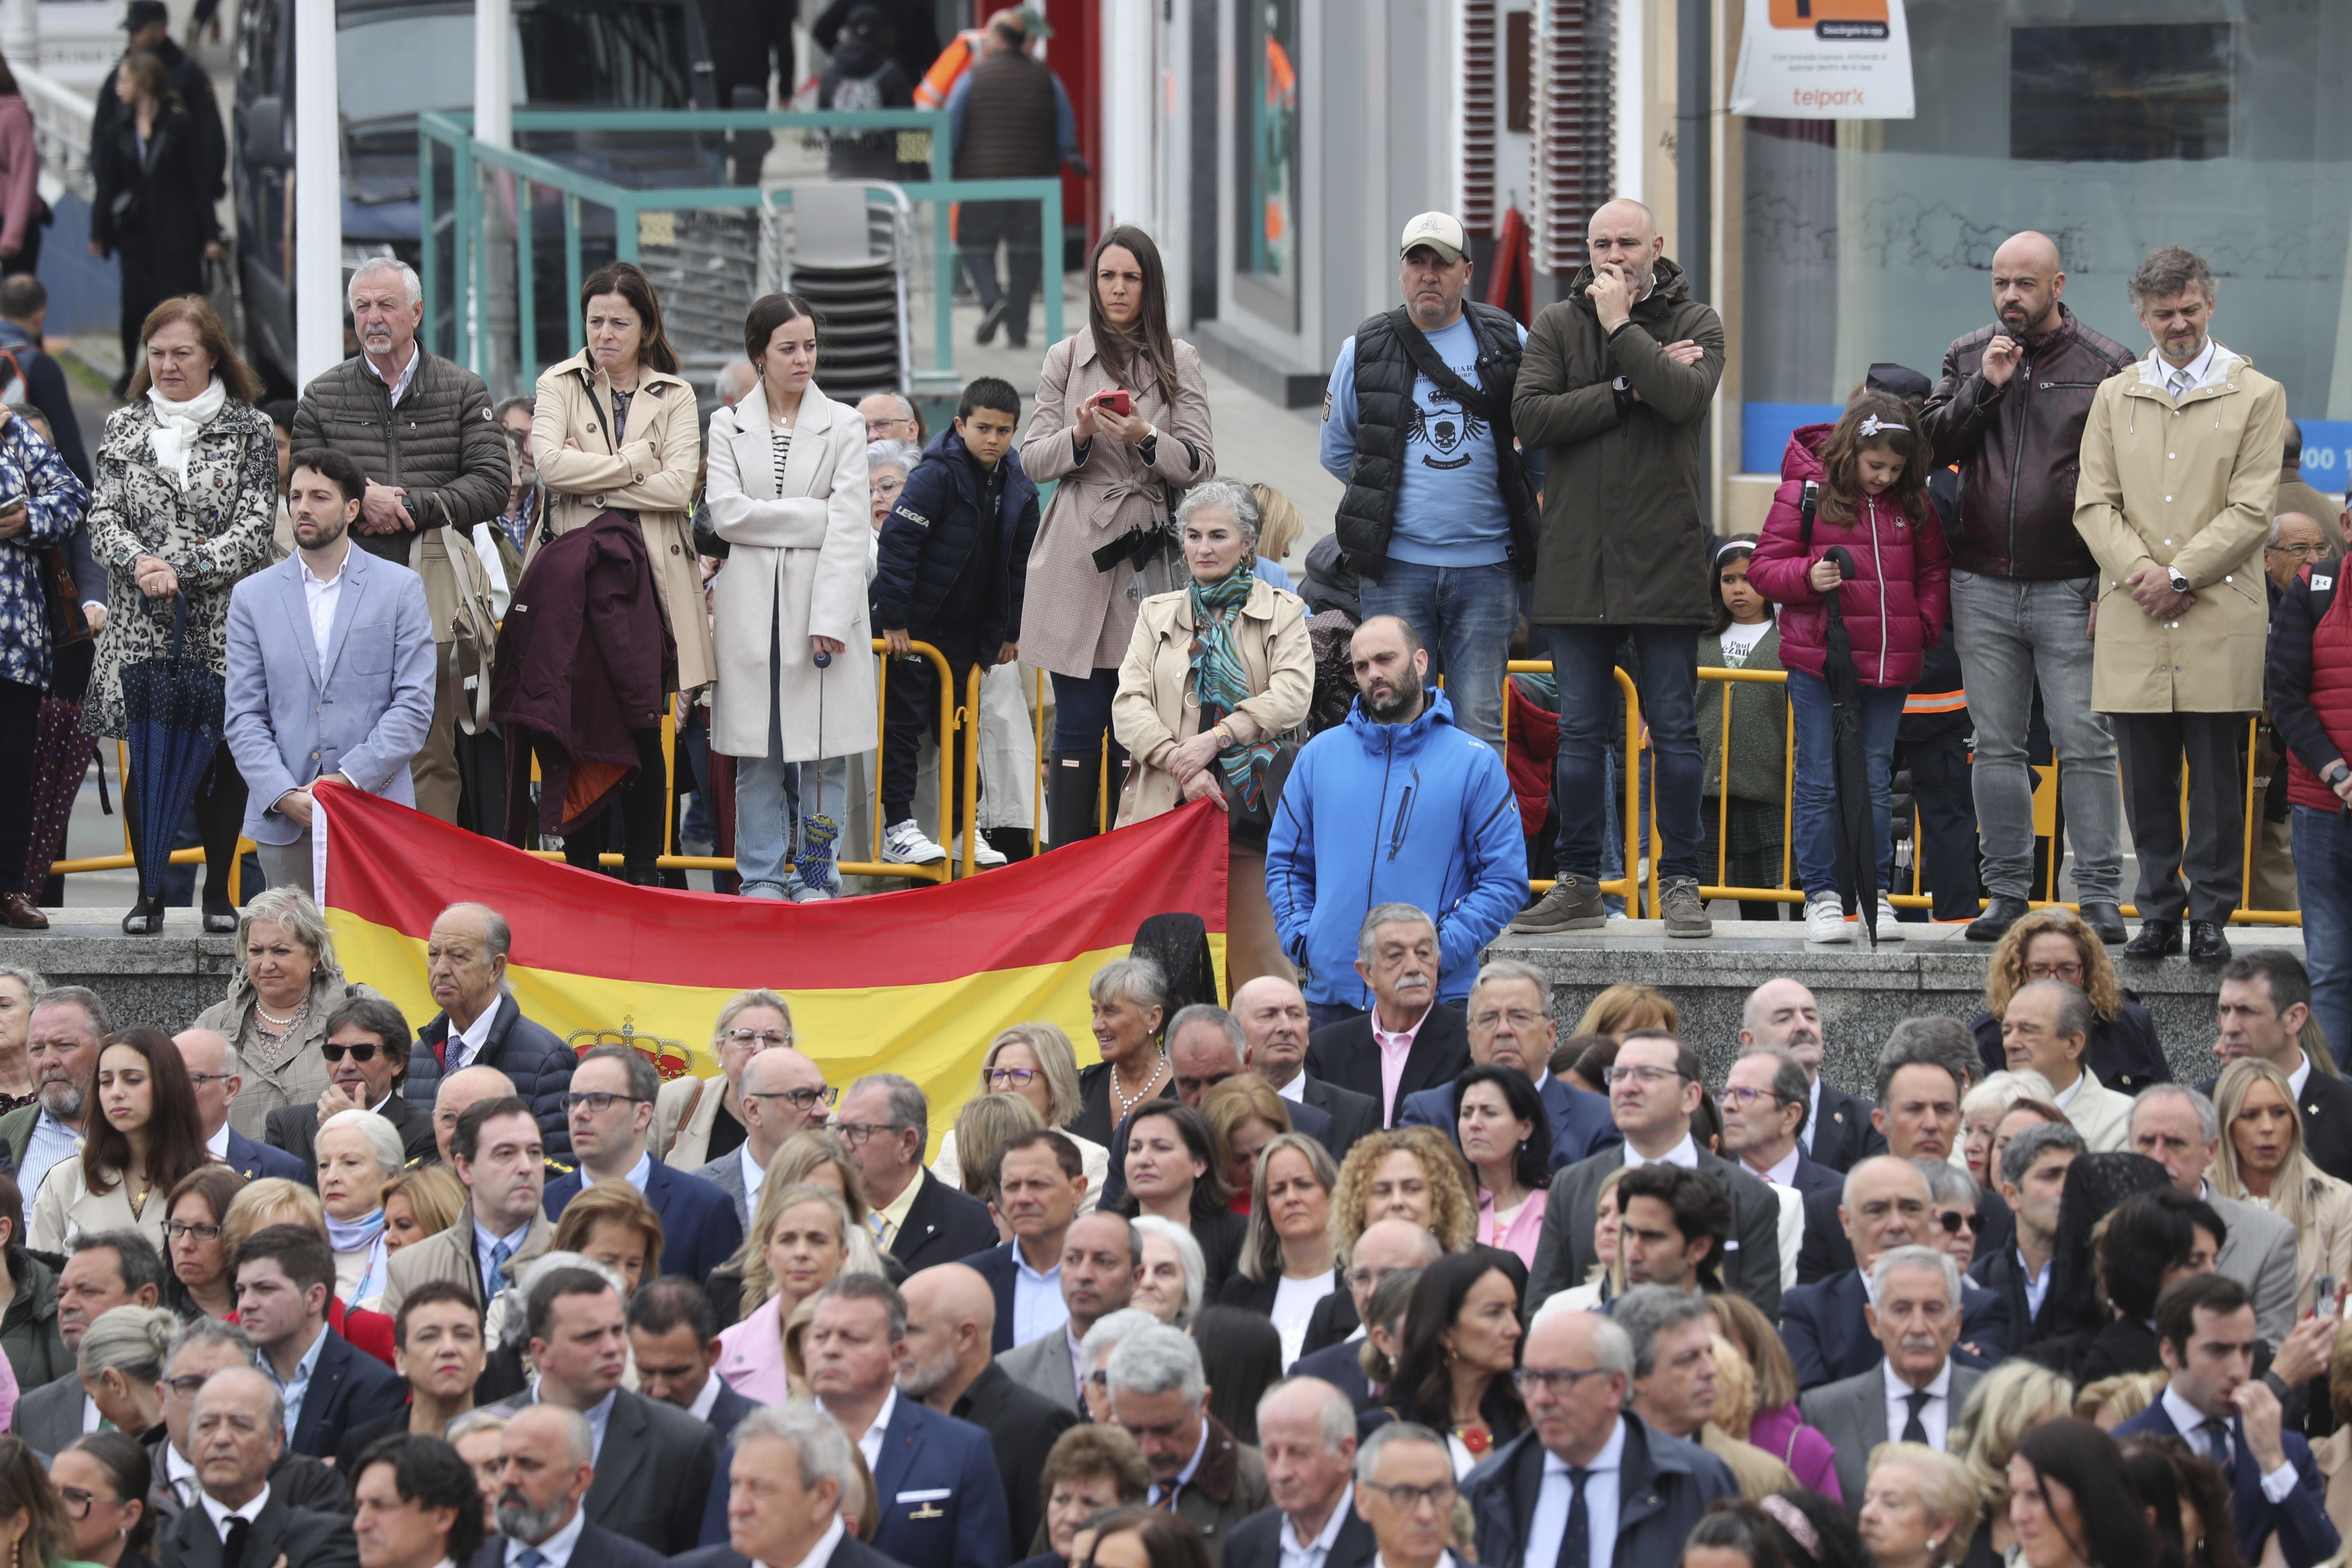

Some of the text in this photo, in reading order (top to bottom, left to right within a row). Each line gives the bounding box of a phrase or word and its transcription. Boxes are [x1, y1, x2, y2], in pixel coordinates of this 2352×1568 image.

[1793, 88, 1864, 109] telpark
[895, 505, 929, 528] LEGEA
[1728, 640, 1751, 649] Paul
